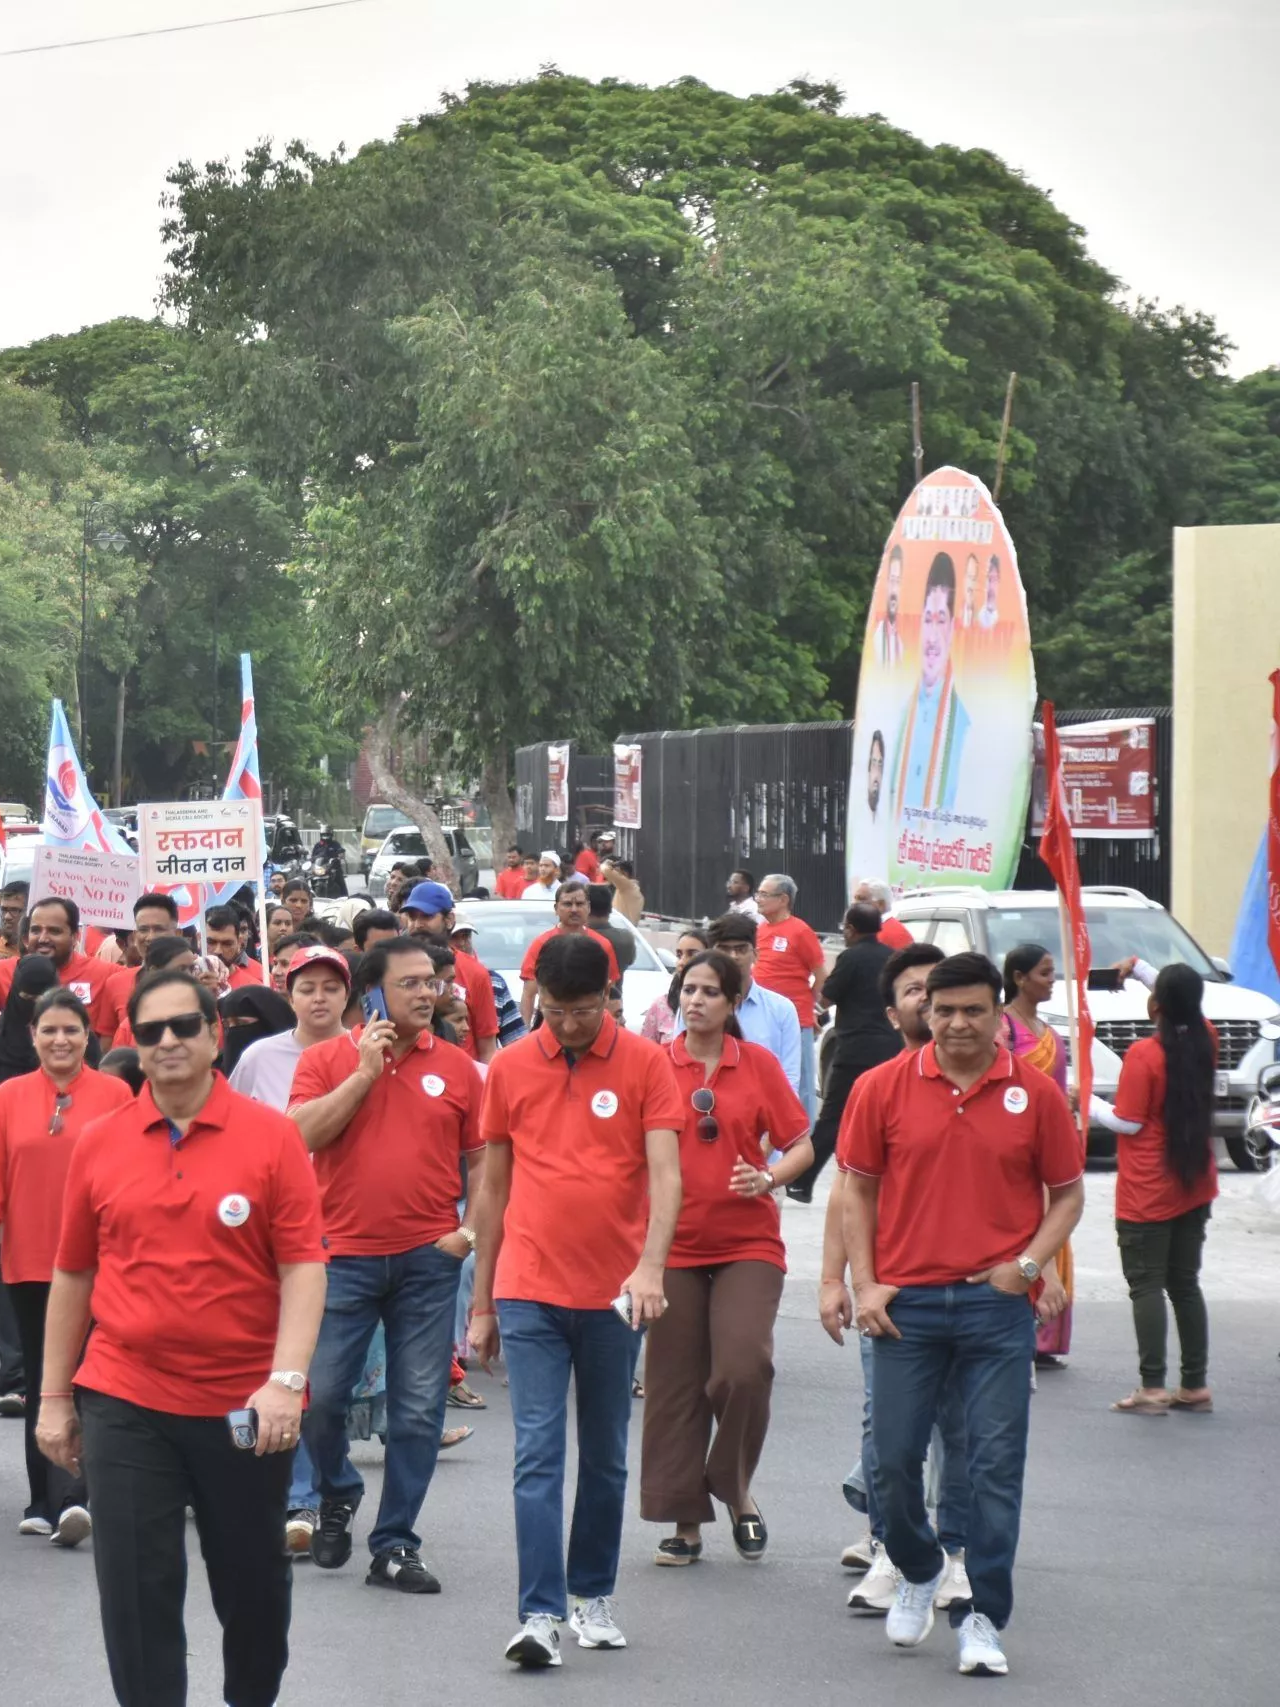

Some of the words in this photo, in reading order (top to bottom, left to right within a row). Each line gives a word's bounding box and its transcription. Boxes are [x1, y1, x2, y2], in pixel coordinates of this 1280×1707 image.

[155, 828, 245, 852] रक्तदान
[155, 854, 208, 875] जीवन
[211, 856, 246, 873] दान
[47, 869, 61, 878] Act
[90, 875, 108, 885] Test
[110, 877, 130, 888] Now
[48, 881, 76, 897] Say
[82, 885, 104, 901] No
[108, 889, 126, 904] to
[80, 907, 124, 920] ssemia
